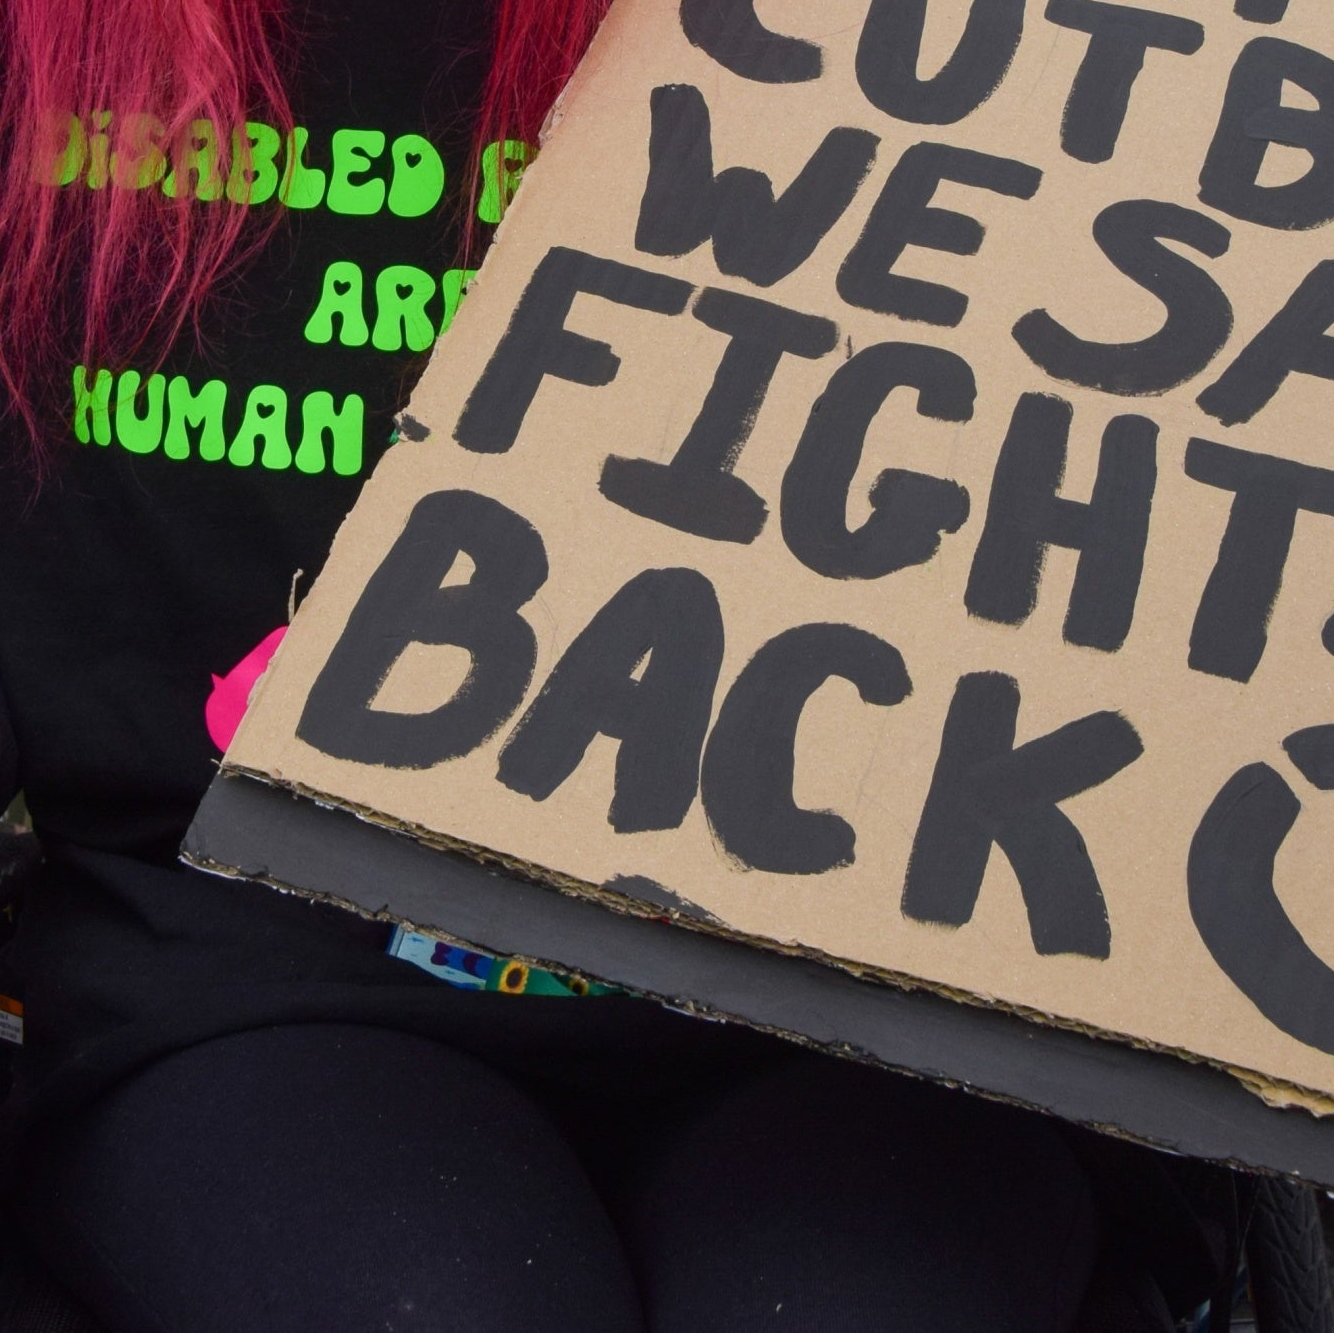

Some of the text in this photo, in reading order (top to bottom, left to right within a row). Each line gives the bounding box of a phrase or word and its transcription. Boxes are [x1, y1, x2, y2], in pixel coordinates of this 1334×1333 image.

[635, 84, 1042, 327] WE
[72, 364, 365, 477] HUMAN
[296, 490, 1144, 961] BACK
